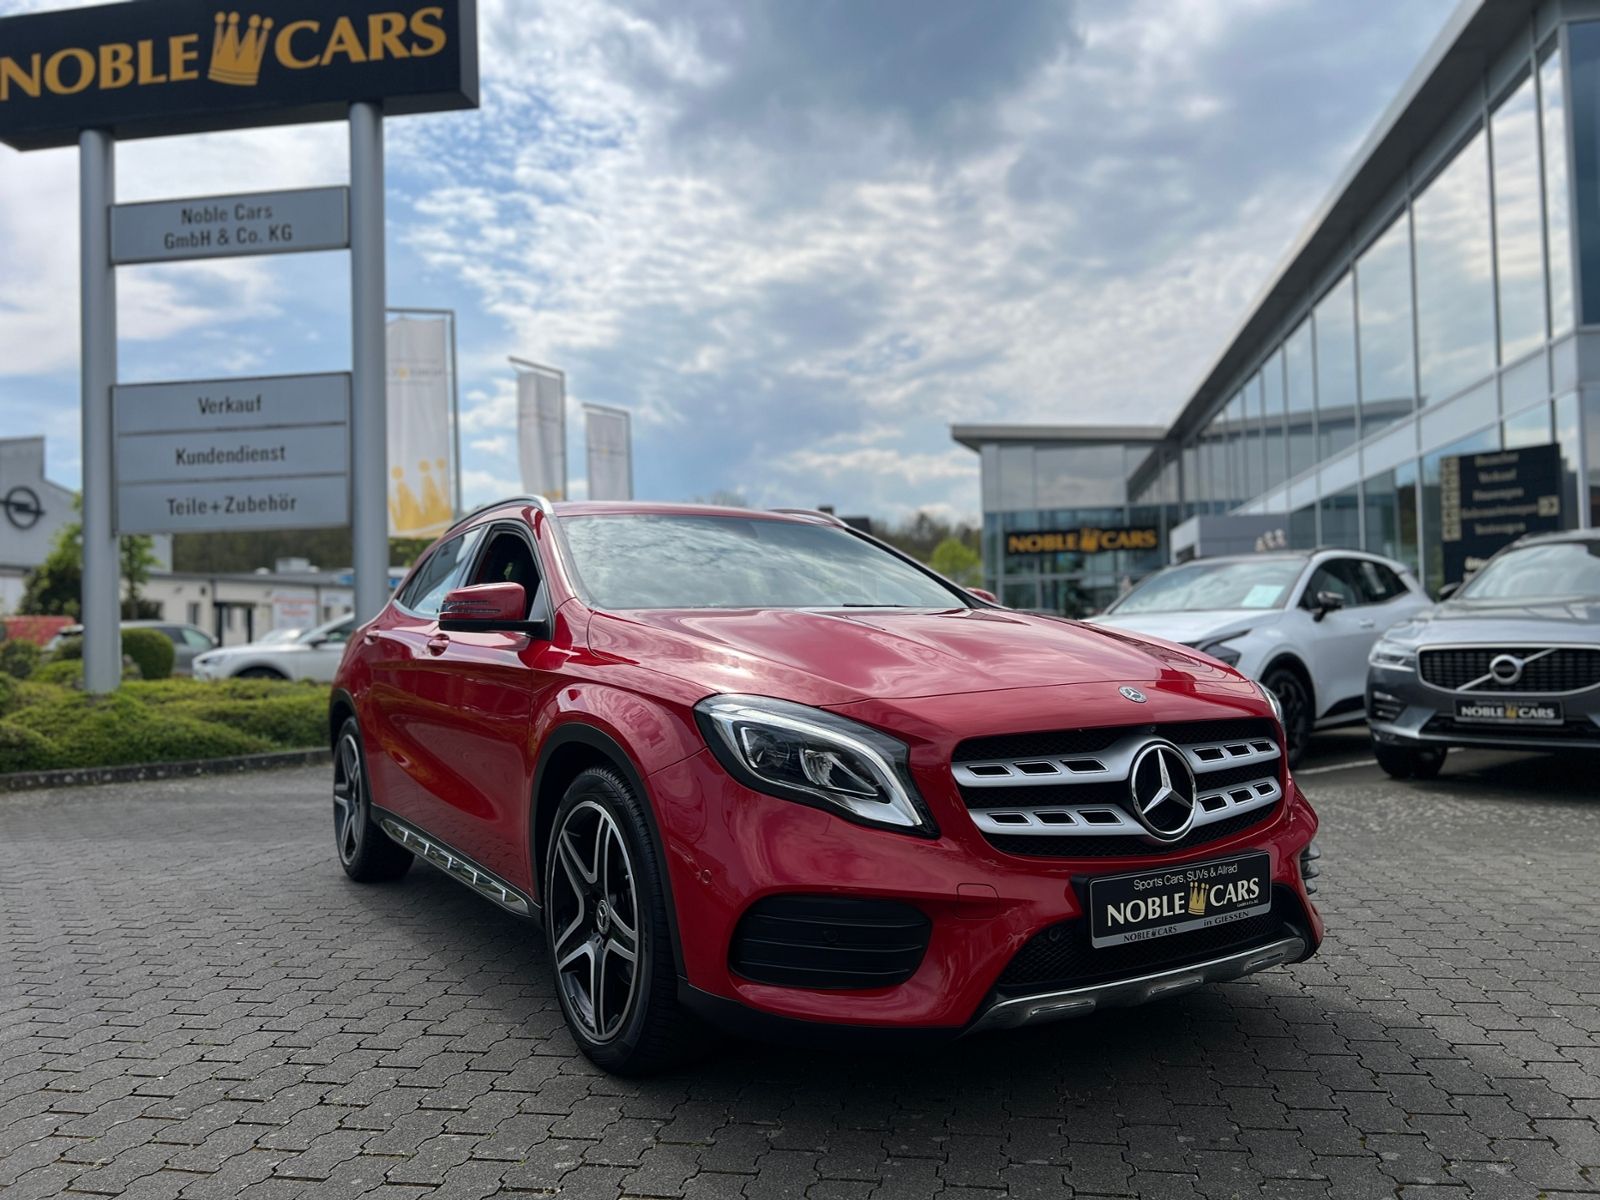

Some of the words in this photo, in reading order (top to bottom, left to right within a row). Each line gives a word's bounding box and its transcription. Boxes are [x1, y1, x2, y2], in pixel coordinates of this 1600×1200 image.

[0, 34, 199, 101] NOBLE
[275, 7, 447, 70] CARS
[181, 206, 228, 224] Noble
[234, 203, 272, 221] Cars
[164, 230, 211, 250] GmbH
[217, 228, 229, 245] &
[236, 226, 262, 244] Co.
[268, 224, 293, 242] KG
[198, 394, 262, 415] Verkauf
[175, 445, 286, 466] Kundendienst
[1007, 533, 1078, 552] NOBLE
[1100, 529, 1158, 549] CARS
[1461, 706, 1505, 718] NOBLE
[1518, 707, 1555, 719] CARS
[1133, 878, 1163, 892] Sports
[1164, 874, 1186, 886] Cars,
[1186, 869, 1209, 882] SUVs
[1209, 867, 1216, 877] &
[1107, 892, 1185, 927] NOBLE
[1209, 877, 1260, 907] CARS
[1203, 919, 1212, 927] in
[1215, 911, 1249, 924] GIESSEN
[1123, 930, 1151, 942] NOBLE
[1157, 926, 1177, 936] CARS
